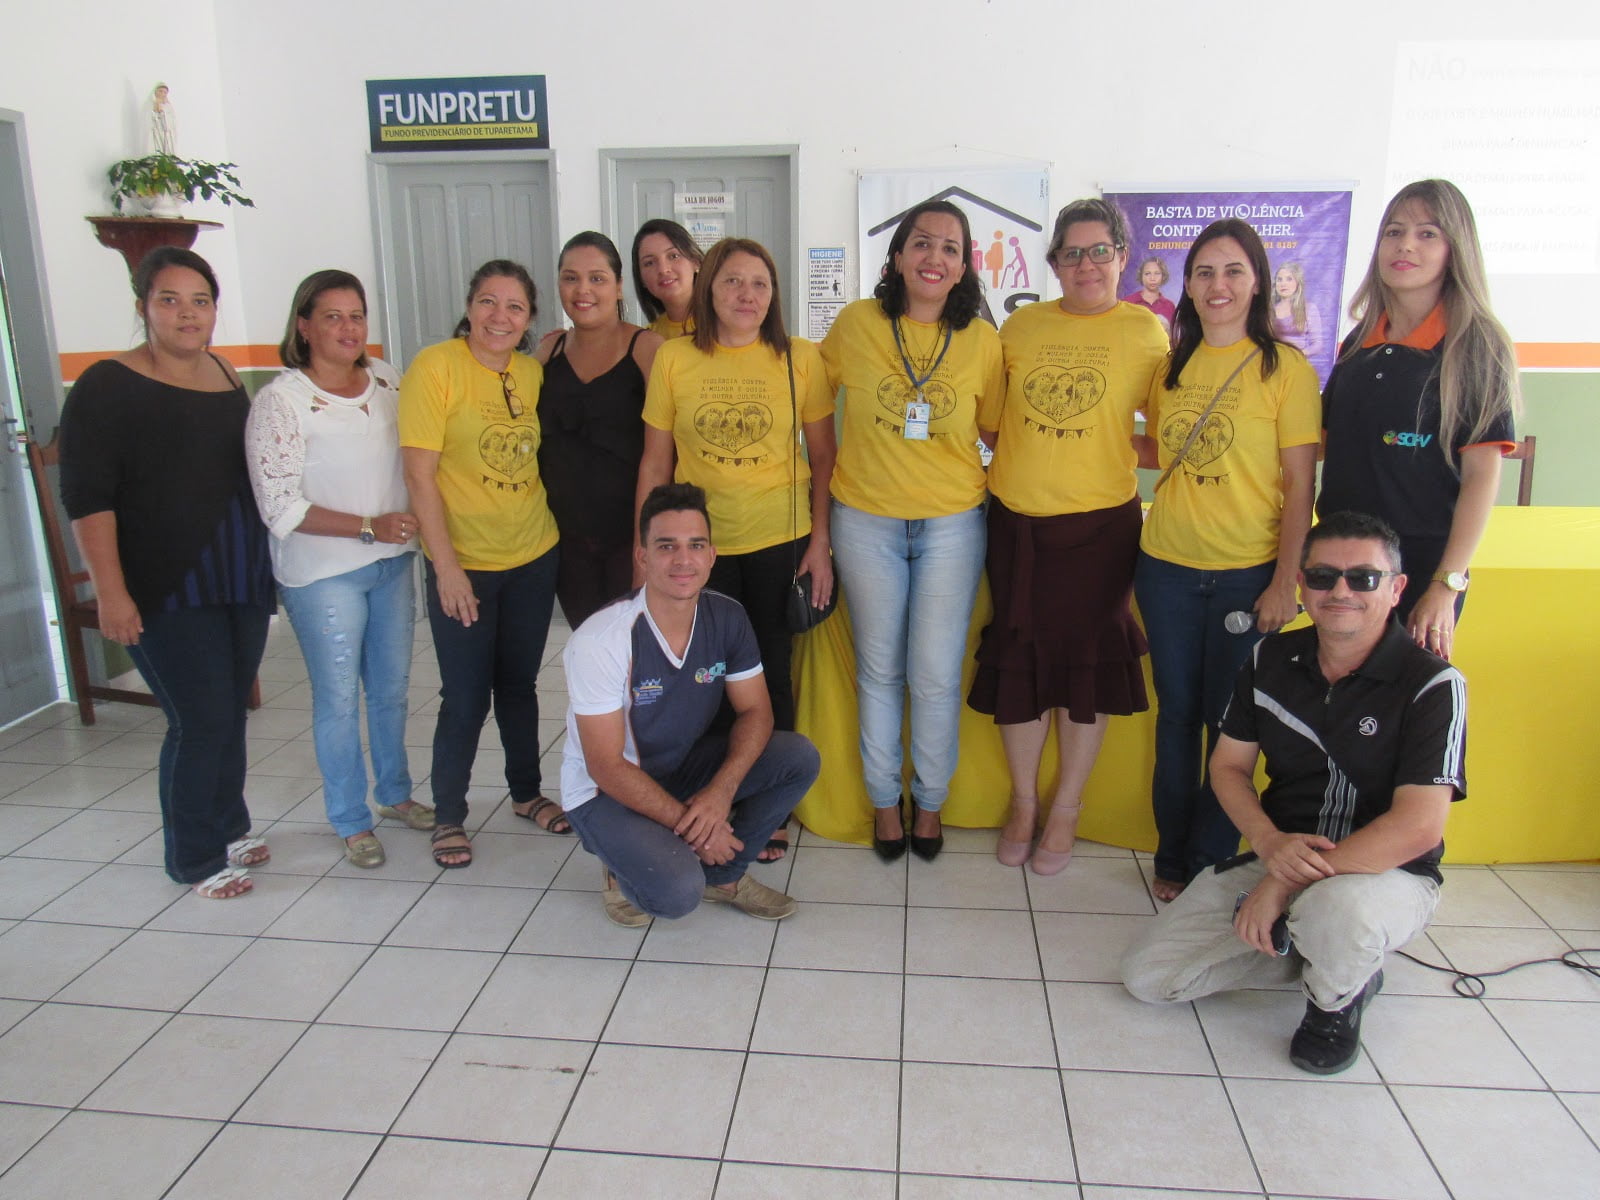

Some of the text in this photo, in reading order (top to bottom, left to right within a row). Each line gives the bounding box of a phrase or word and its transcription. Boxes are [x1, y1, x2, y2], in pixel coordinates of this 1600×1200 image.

[378, 89, 536, 125] FUNPRETU
[385, 129, 411, 137] FUNDO
[412, 126, 472, 137] PREVIDENCIÁRIO
[485, 126, 534, 135] TUPARETAMA
[1146, 203, 1305, 220] BASTA DE VIOLÊNCIA
[1152, 224, 1210, 237] CONTR
[1249, 224, 1295, 237] LHER.
[1148, 241, 1194, 250] DENUNCI
[810, 250, 843, 258] HIGIENE
